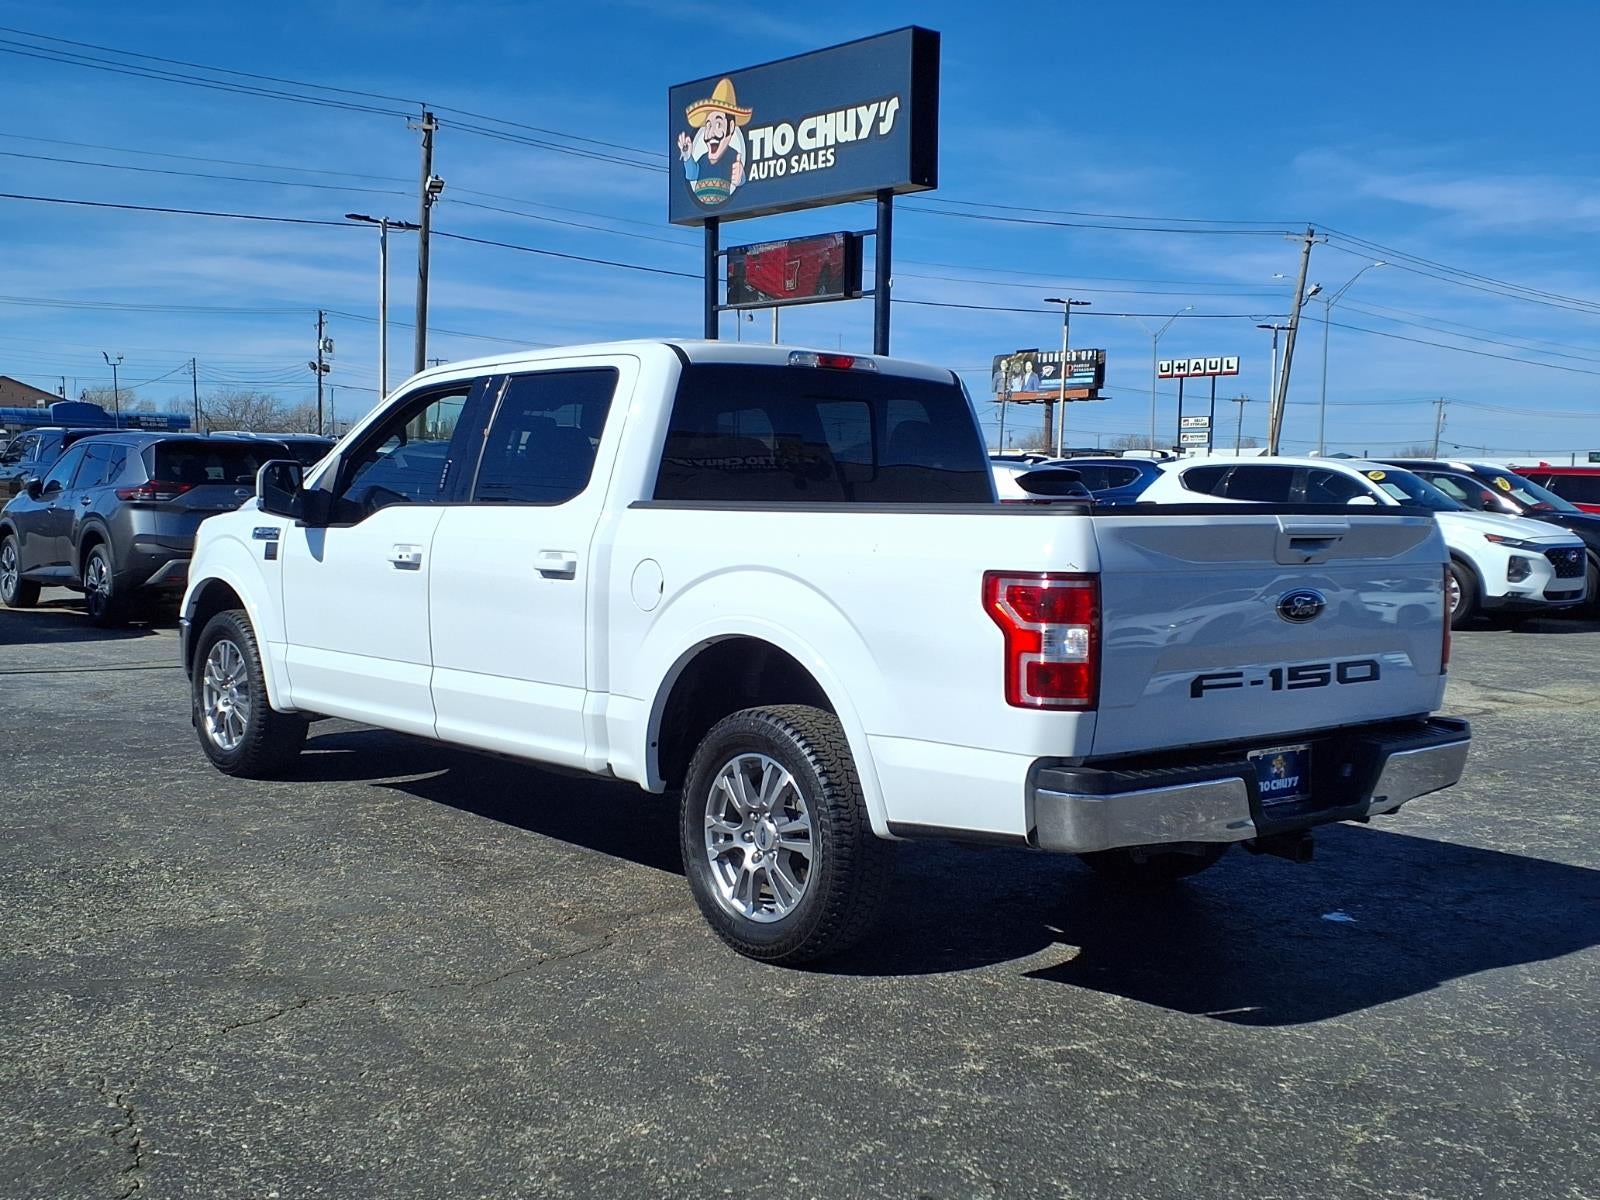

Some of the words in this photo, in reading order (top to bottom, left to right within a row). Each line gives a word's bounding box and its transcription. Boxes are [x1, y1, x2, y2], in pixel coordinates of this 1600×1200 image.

[748, 123, 795, 160] TIO
[797, 96, 900, 150] CHUY'S
[748, 157, 787, 181] AUTO
[790, 148, 835, 174] SALES
[1190, 659, 1381, 698] F-150
